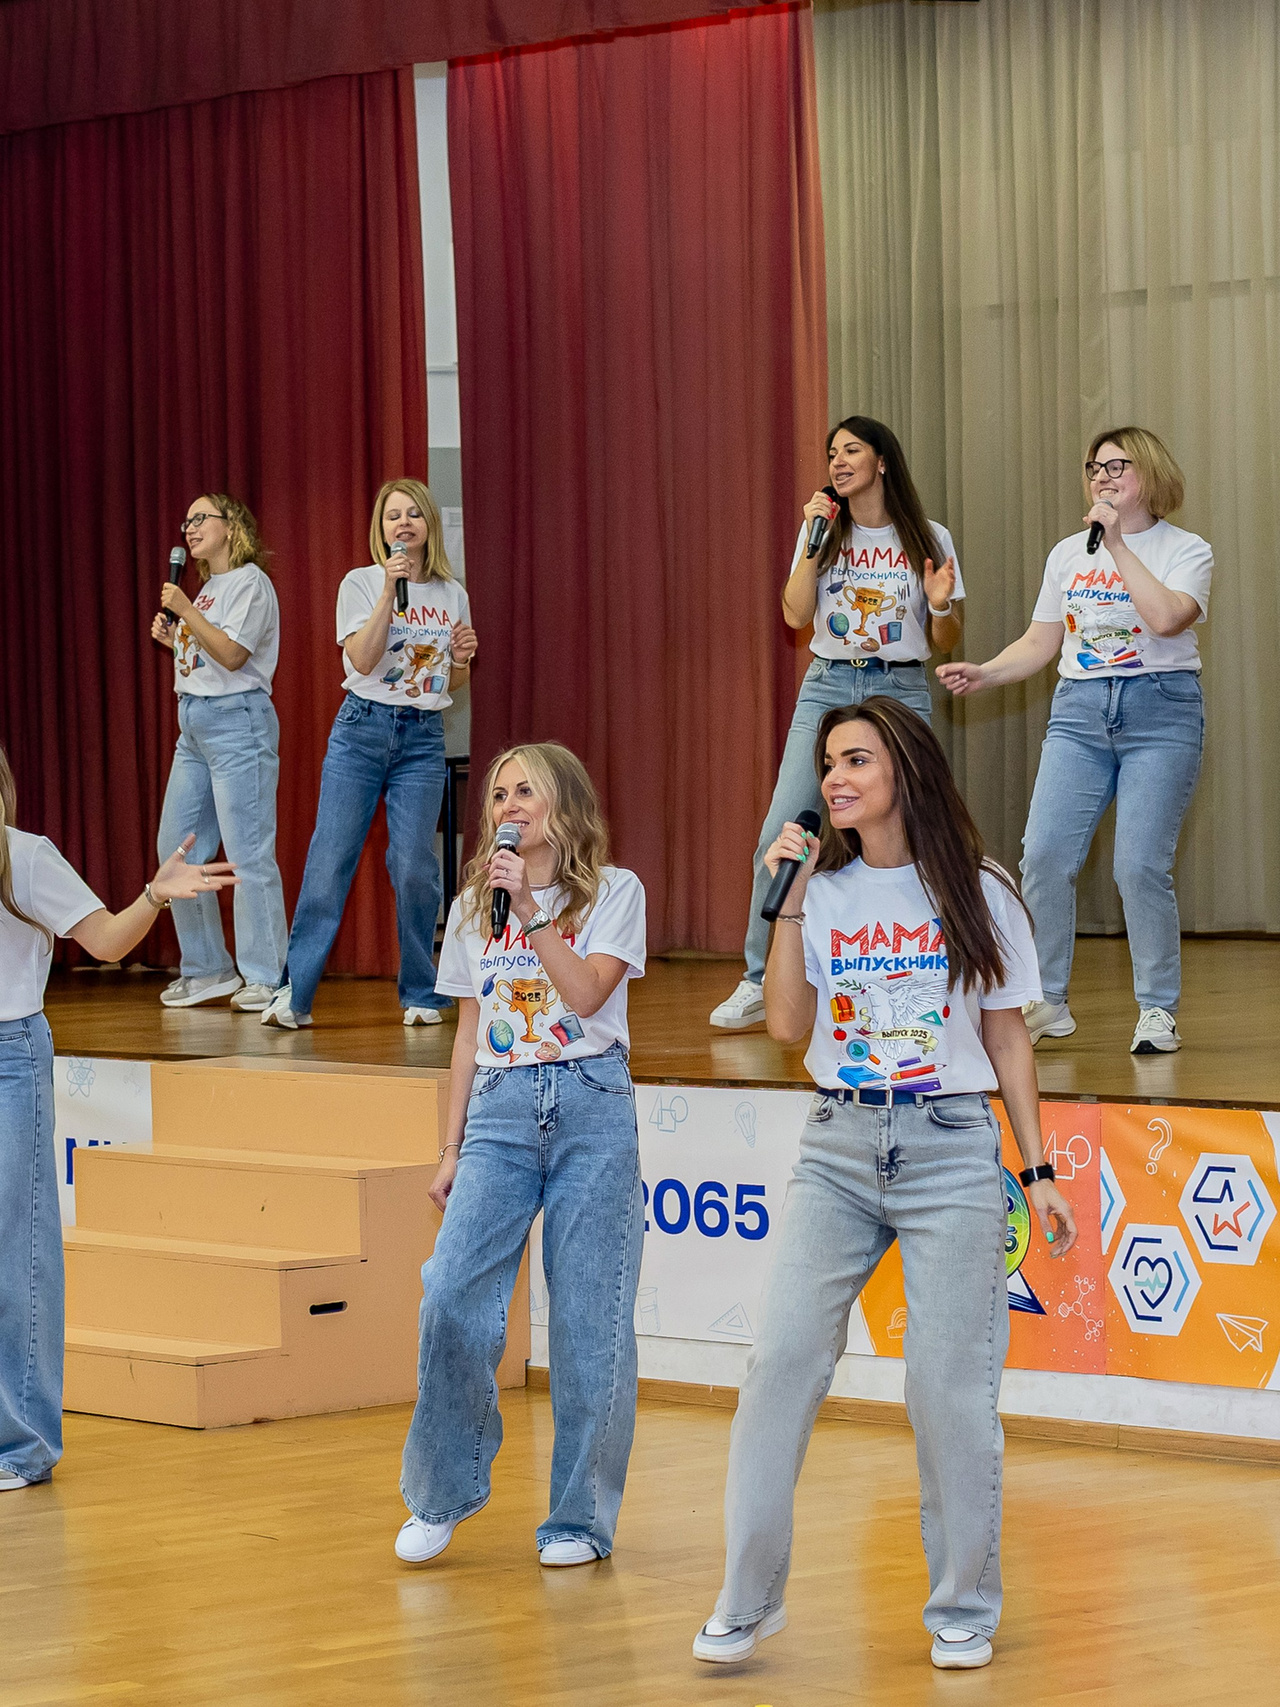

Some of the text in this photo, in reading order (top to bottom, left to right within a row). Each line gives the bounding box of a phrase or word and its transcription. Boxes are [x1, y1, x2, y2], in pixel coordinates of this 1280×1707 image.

[834, 546, 909, 570] МАМА
[1070, 568, 1129, 591] МАМ
[1066, 588, 1133, 603] ВЫПУСКНИ
[483, 919, 577, 956] МАА
[830, 955, 949, 976] ВЫПУСКНИК
[514, 991, 542, 1003] 2025
[909, 1028, 928, 1039] 2025
